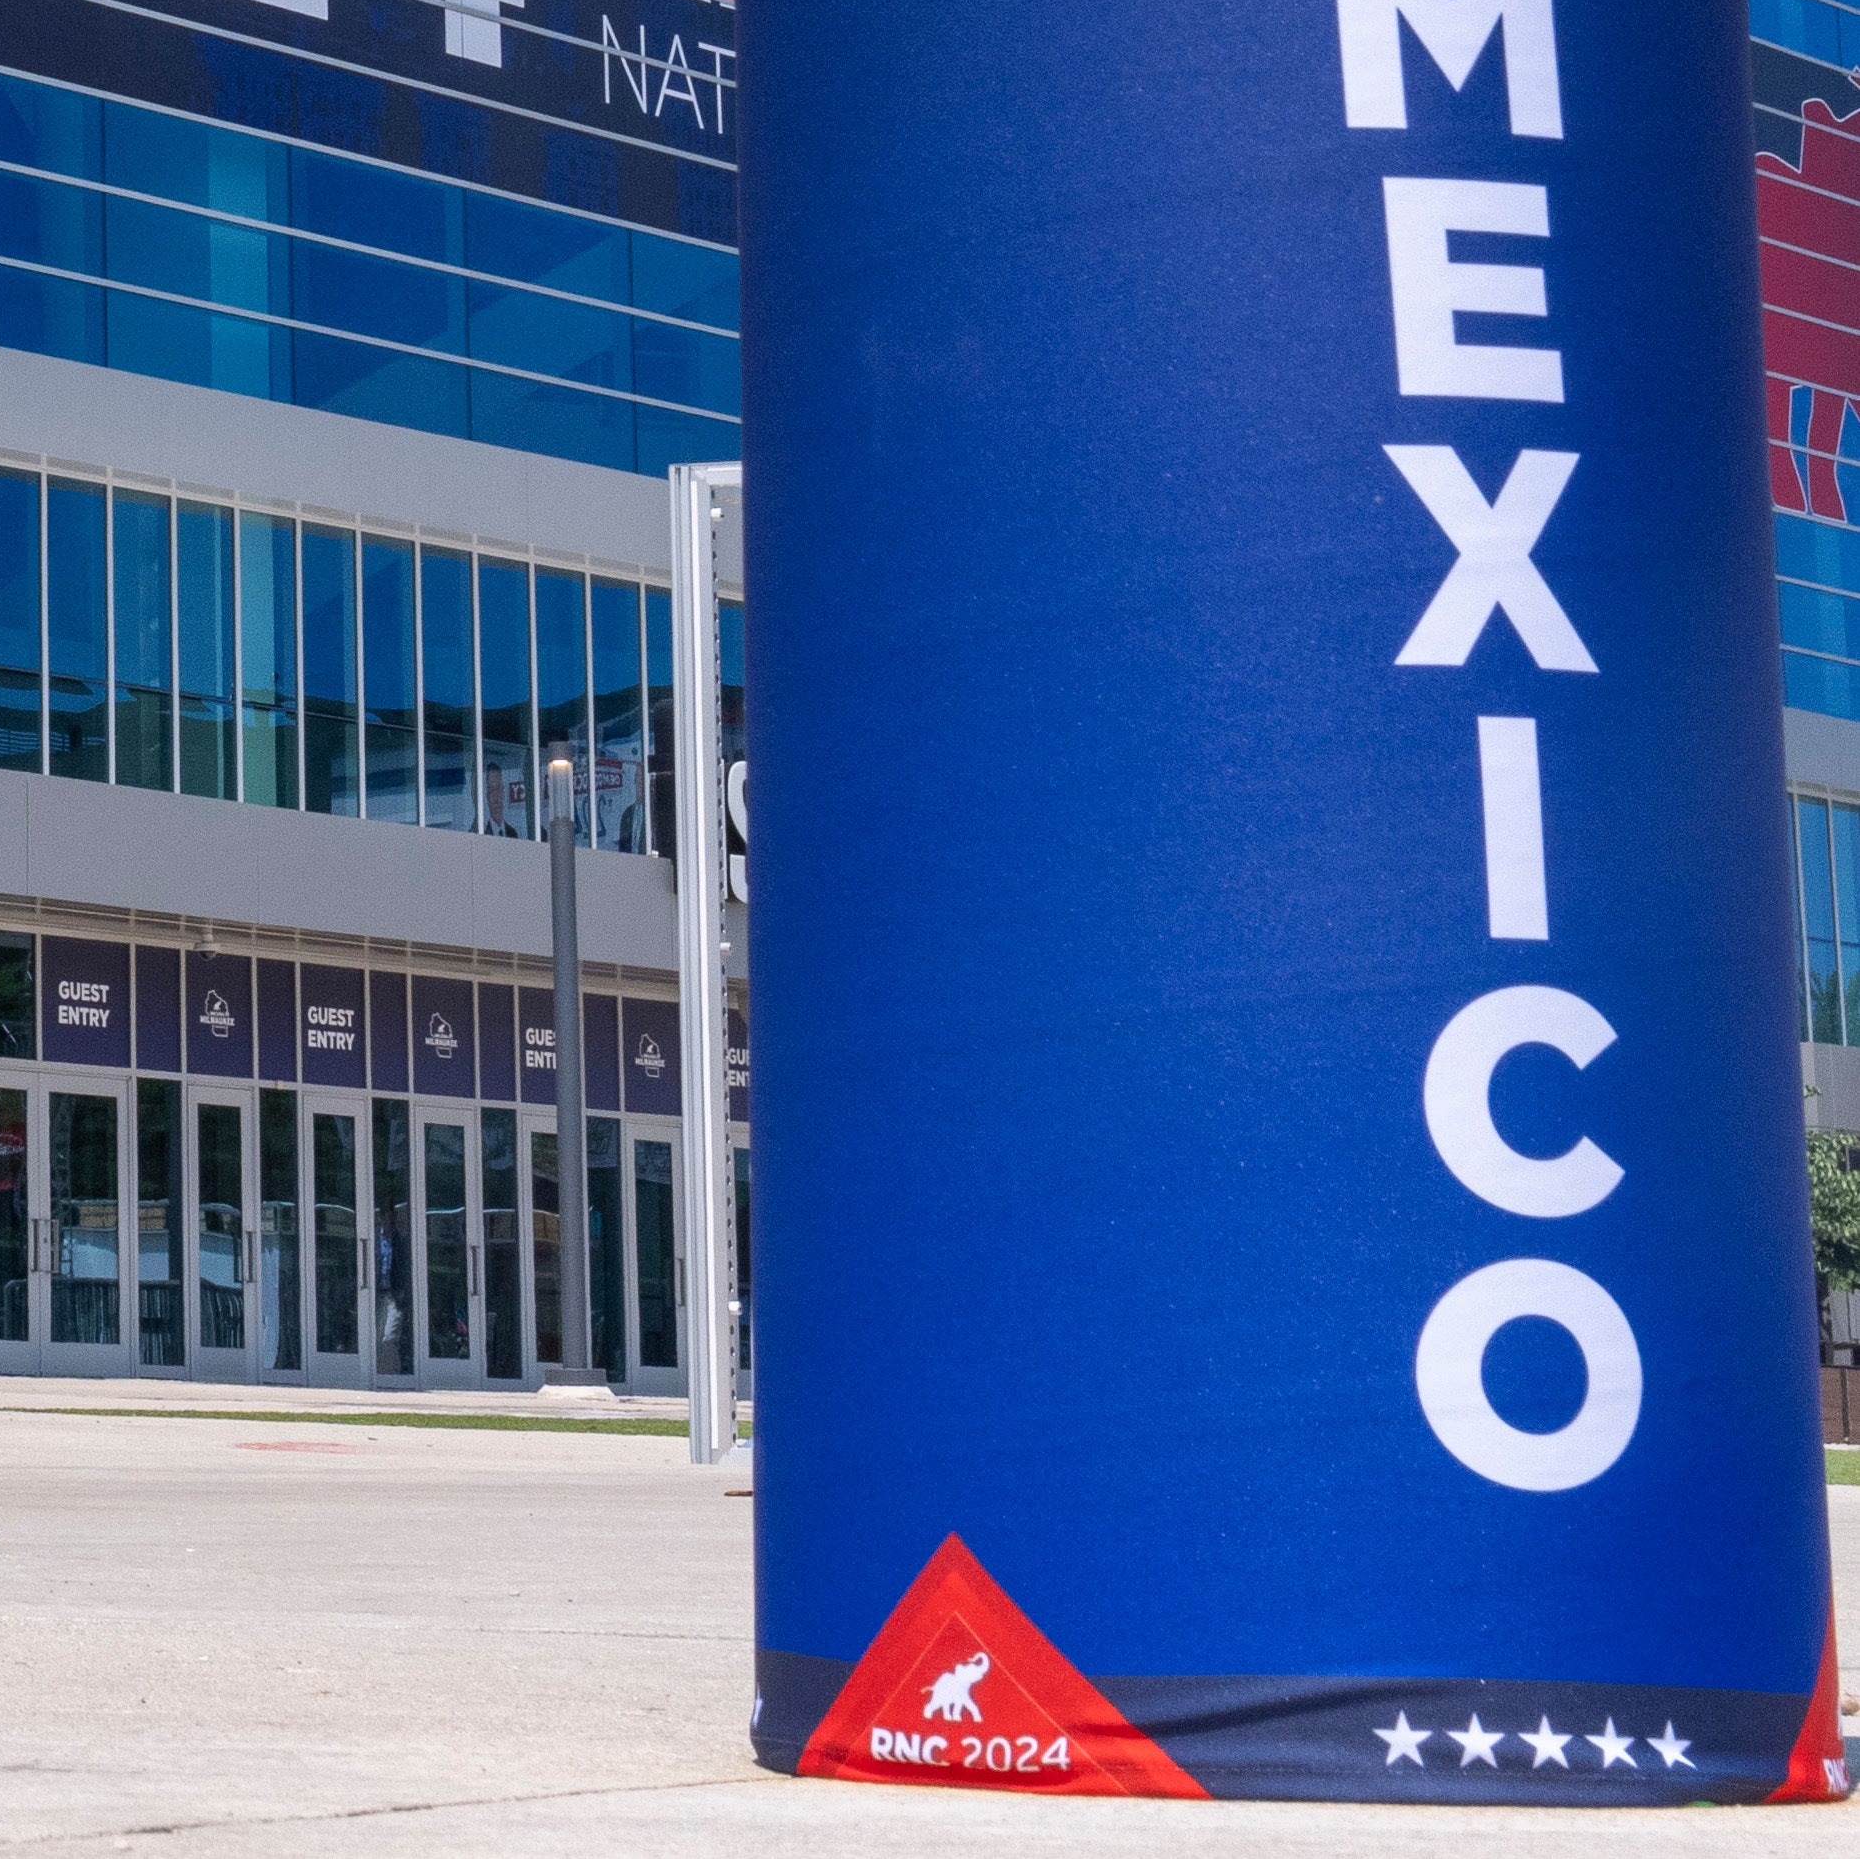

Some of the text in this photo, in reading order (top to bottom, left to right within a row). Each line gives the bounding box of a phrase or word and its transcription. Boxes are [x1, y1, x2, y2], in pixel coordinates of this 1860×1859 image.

[58, 980, 110, 1003] GUEST
[57, 1004, 110, 1028] ENTRY
[307, 1005, 355, 1028] GUEST
[307, 1029, 355, 1052] ENTRY
[870, 1726, 1071, 1772] RNC 2024
